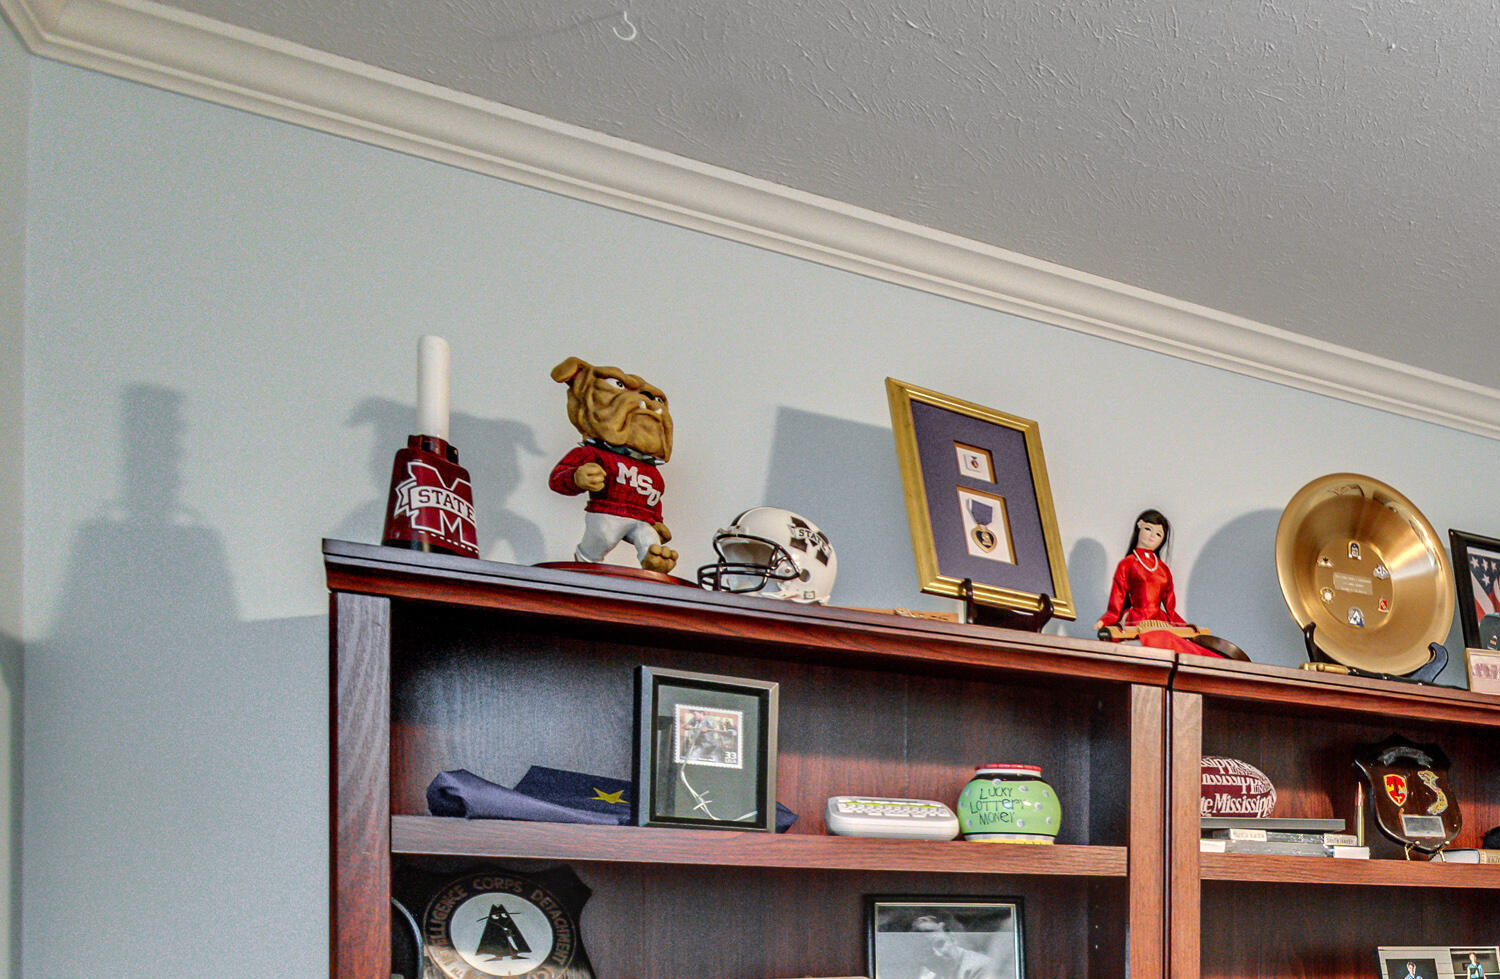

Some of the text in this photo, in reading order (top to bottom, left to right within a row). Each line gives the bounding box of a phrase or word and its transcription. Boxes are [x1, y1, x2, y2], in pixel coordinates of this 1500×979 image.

[616, 461, 661, 507] MSU
[418, 488, 477, 520] STATE
[979, 786, 1013, 800] LUCKY
[472, 877, 524, 894] CORPS
